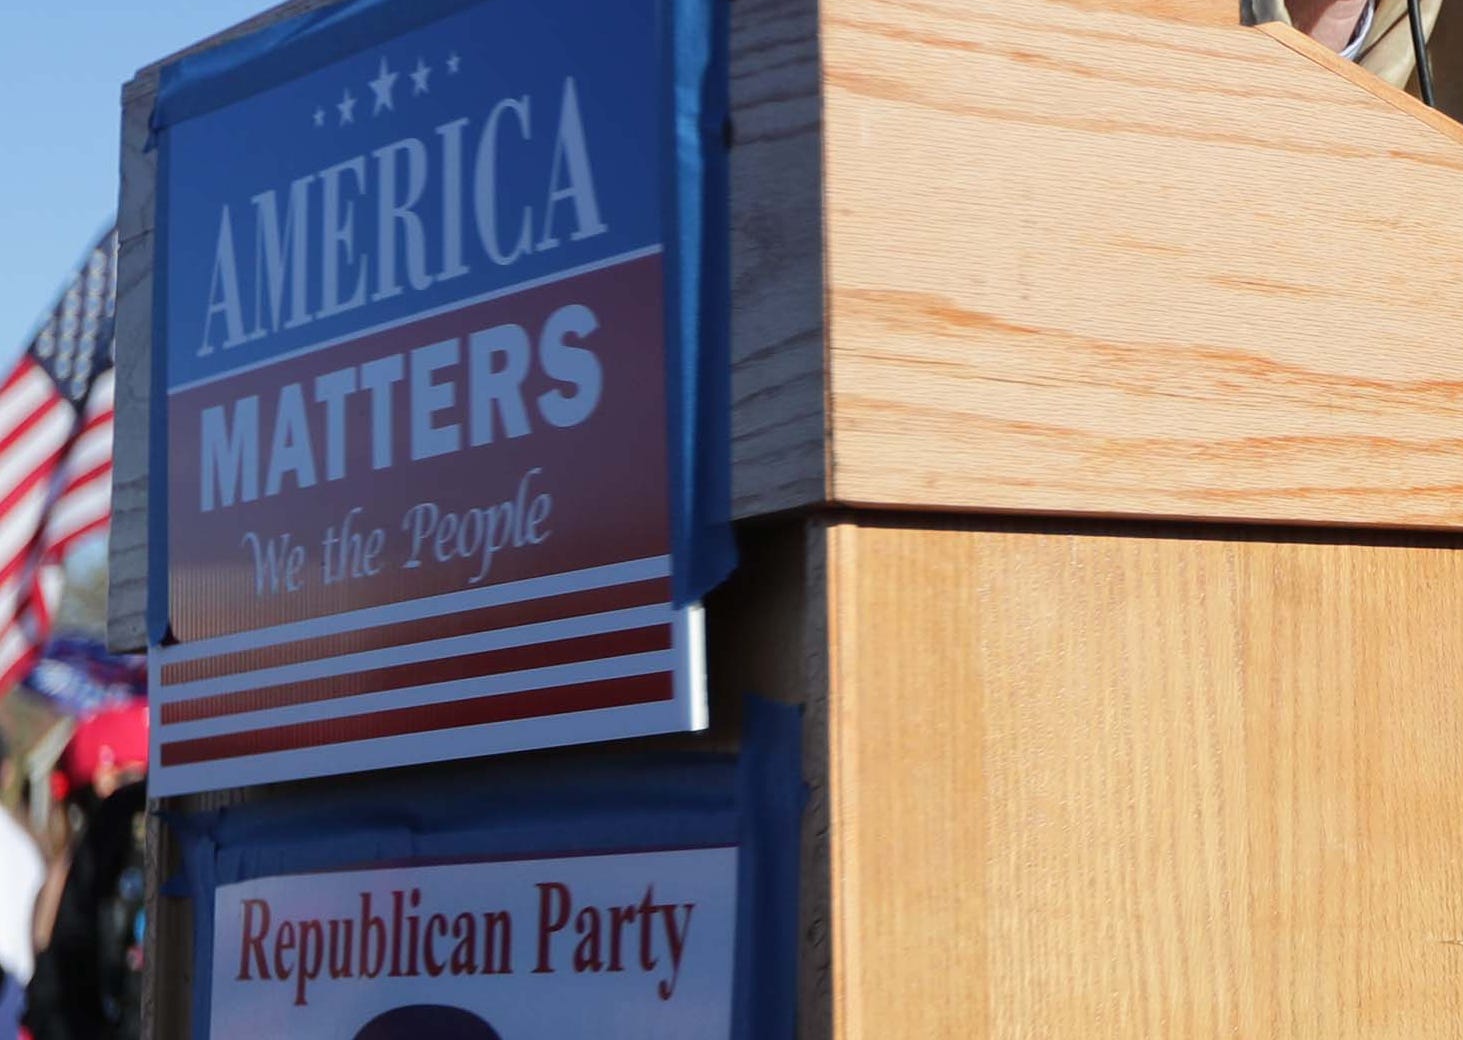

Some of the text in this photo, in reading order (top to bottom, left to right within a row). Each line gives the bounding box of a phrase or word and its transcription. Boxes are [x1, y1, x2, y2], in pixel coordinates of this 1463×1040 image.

[196, 75, 608, 358] AMERICA
[200, 304, 603, 513] MATTERS
[241, 467, 553, 597] We the People
[235, 881, 695, 1006] Republican Party
